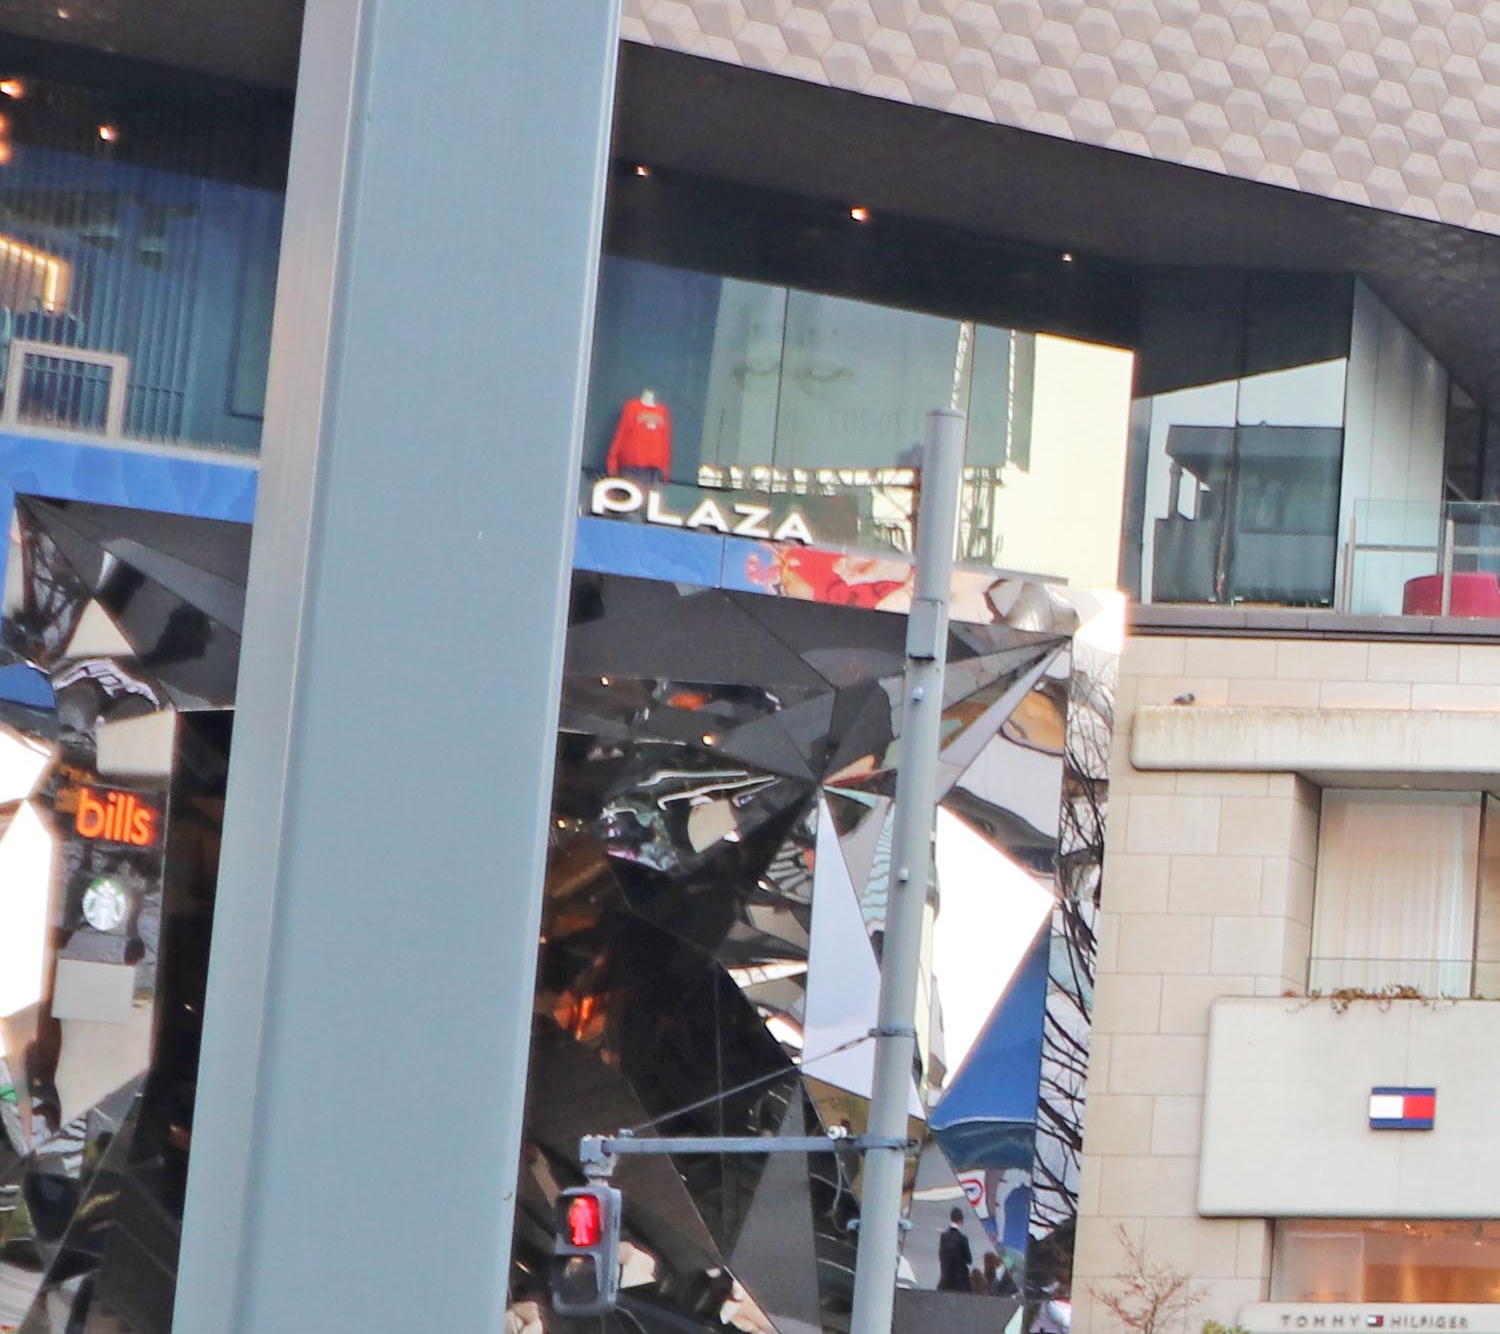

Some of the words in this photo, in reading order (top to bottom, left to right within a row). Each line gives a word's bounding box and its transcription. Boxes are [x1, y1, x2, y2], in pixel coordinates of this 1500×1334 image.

[590, 476, 814, 545] PLAZA
[75, 787, 154, 846] bills
[1280, 1314, 1361, 1328] TOMMY
[1391, 1315, 1469, 1330] HILFIGER
